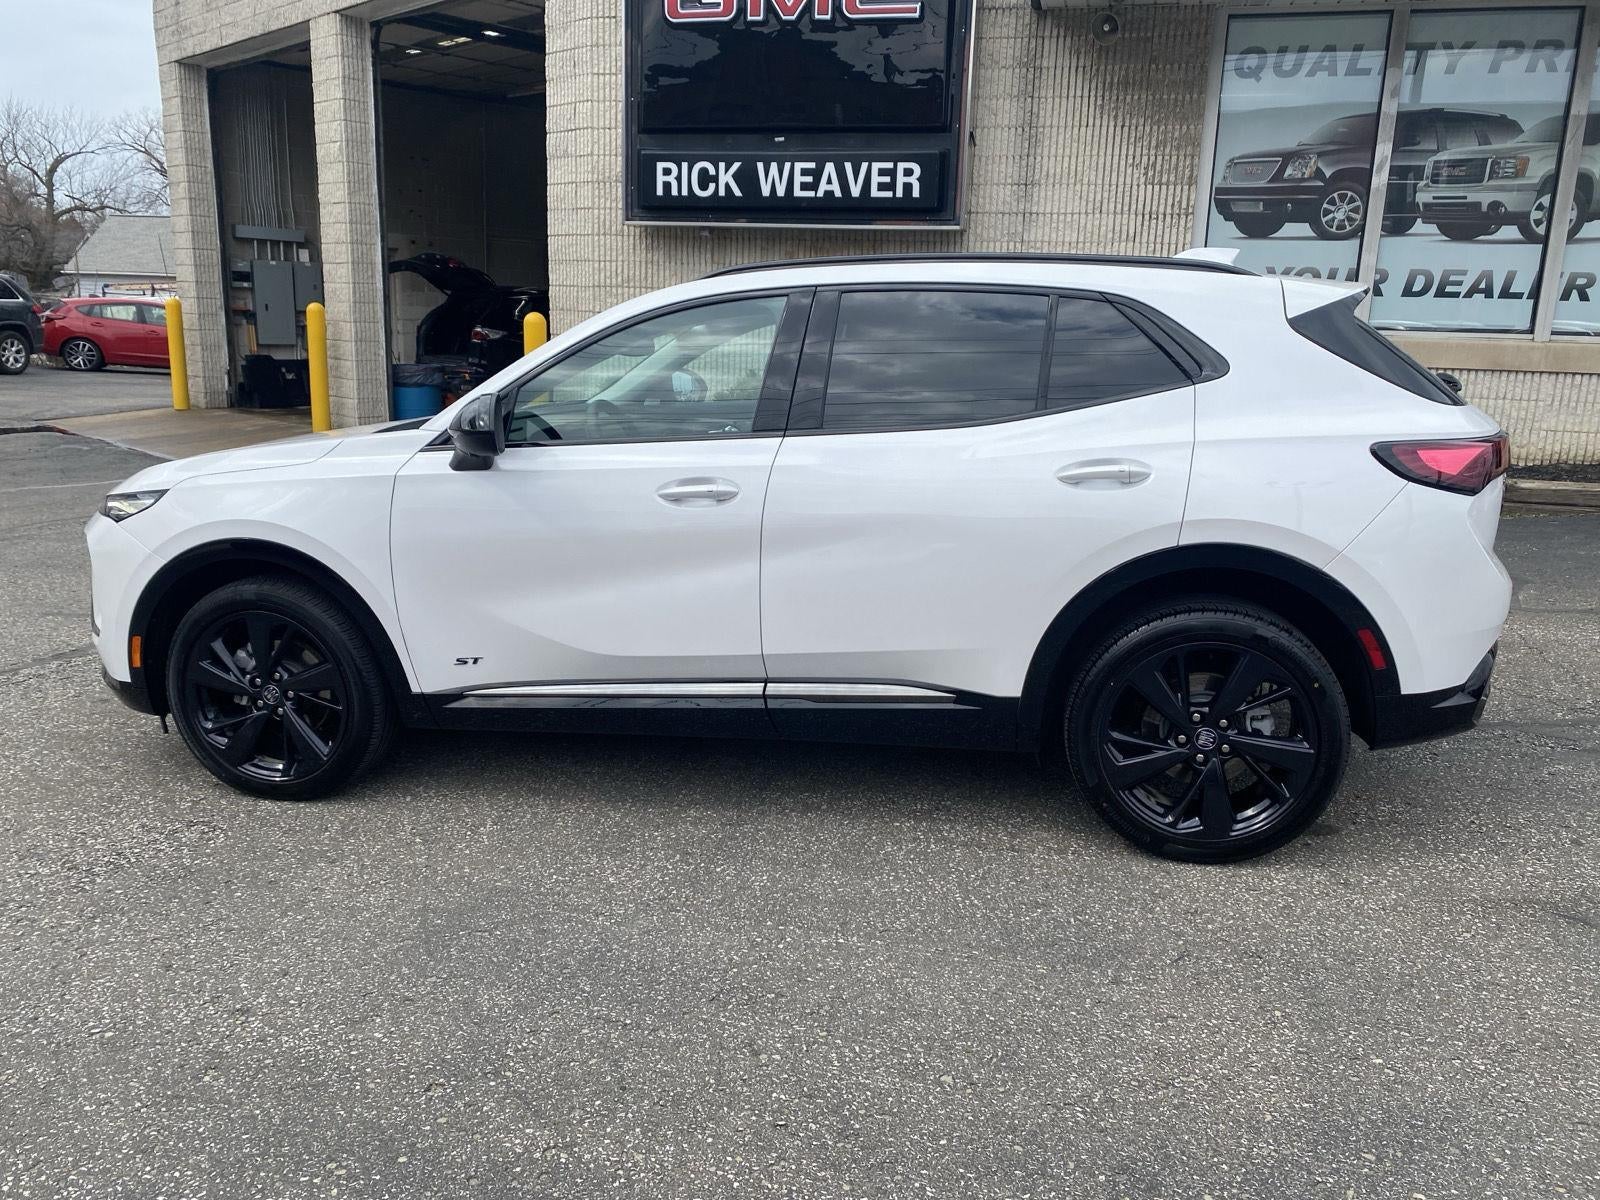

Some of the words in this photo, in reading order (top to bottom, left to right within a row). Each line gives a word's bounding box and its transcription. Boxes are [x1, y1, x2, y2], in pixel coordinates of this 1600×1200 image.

[1234, 40, 1477, 83] QUALTY
[1487, 38, 1600, 74] PR
[656, 161, 743, 197] RICK
[756, 161, 922, 198] WEAVER
[1401, 268, 1597, 302] DEALR
[453, 656, 484, 666] ST
